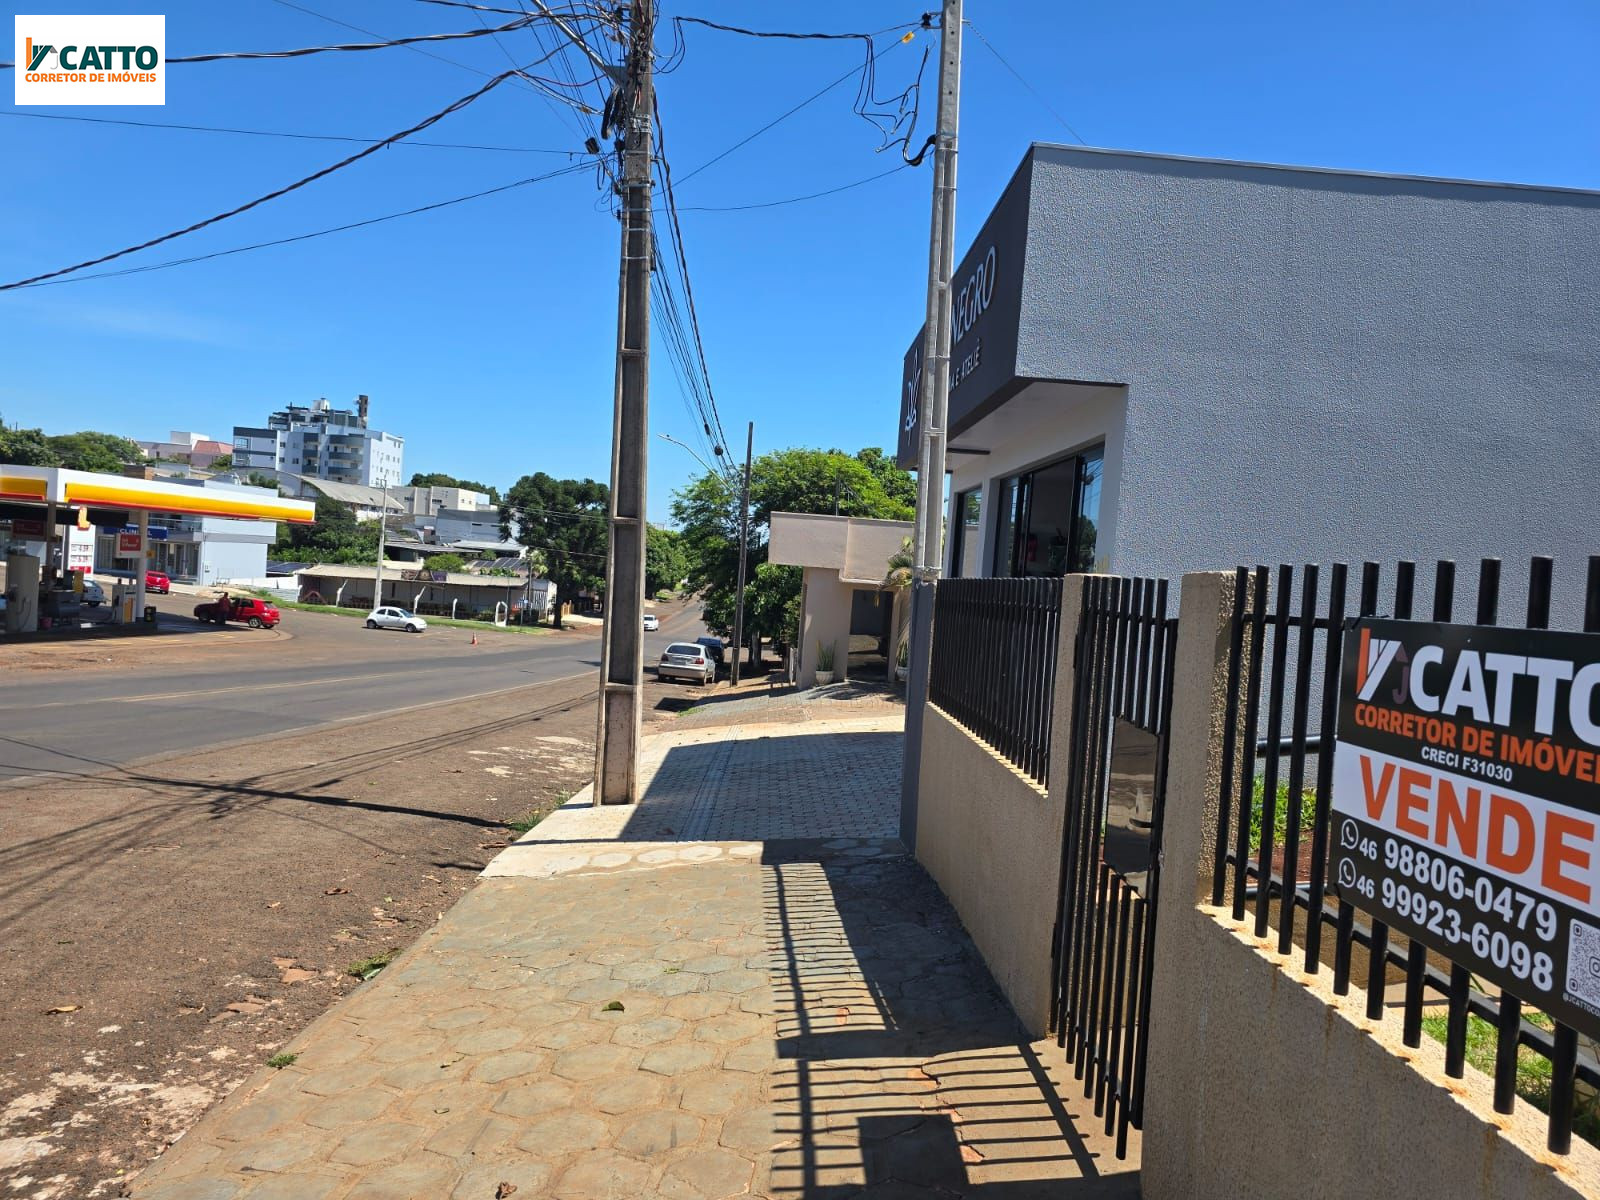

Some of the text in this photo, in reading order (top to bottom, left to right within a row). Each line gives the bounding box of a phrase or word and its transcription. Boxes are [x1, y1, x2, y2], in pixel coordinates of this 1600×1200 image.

[951, 245, 996, 345] NEGRO
[1354, 703, 1457, 748] CORRETOR
[1462, 726, 1495, 757] DE
[1421, 746, 1513, 782] CRECI F31030
[1360, 754, 1595, 905] VENDE
[1356, 875, 1554, 992] 46 99923-6098
[1359, 837, 1558, 942] 46 98806-0479
